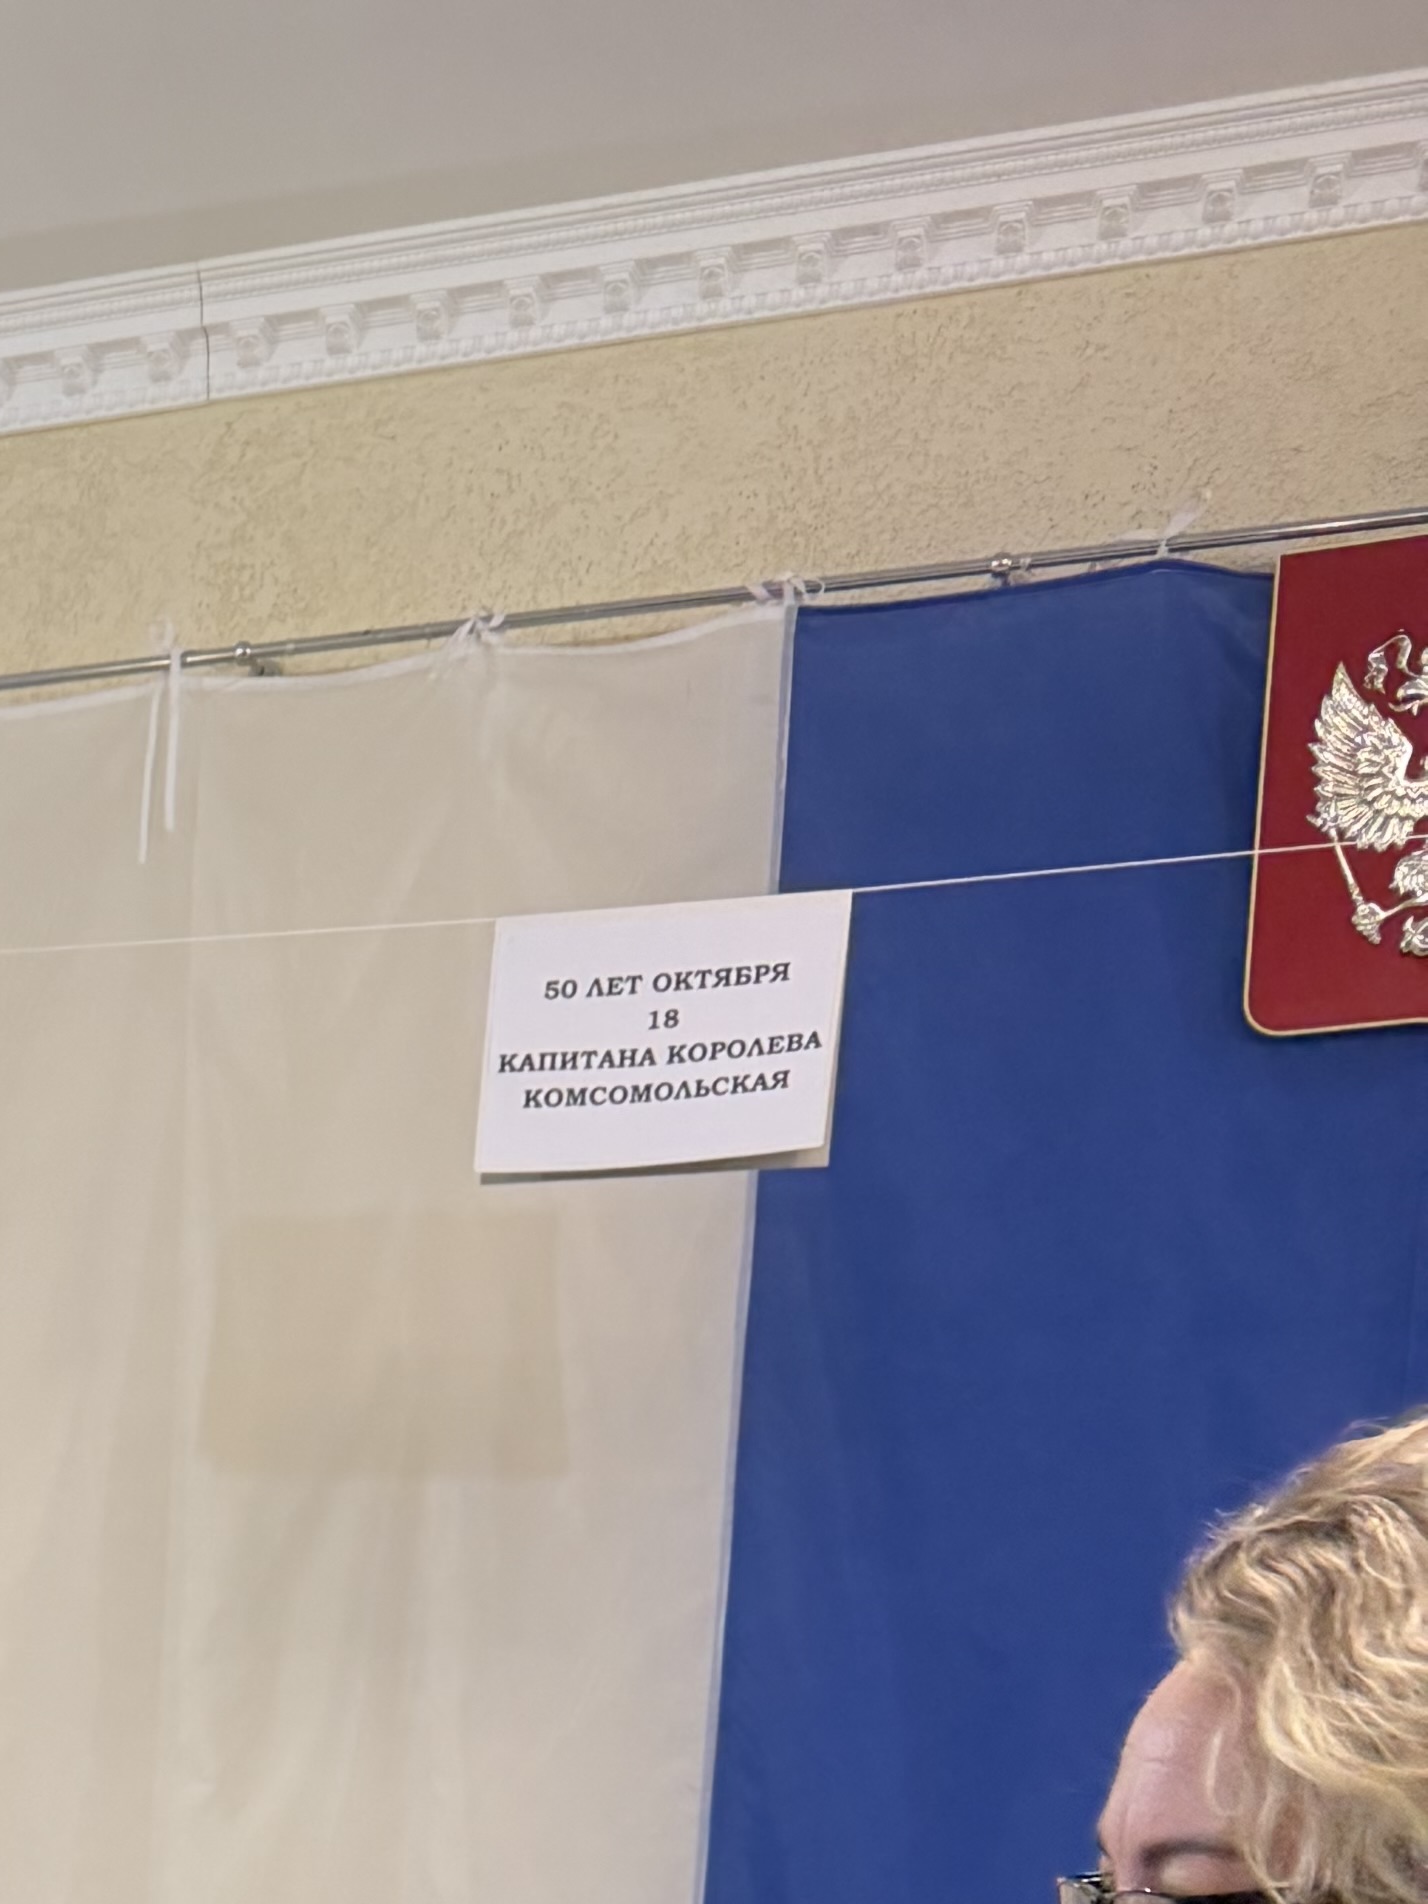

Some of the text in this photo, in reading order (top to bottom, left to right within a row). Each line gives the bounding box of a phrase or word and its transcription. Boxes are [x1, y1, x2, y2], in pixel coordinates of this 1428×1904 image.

[544, 962, 791, 1001] 50 ЛЕТ ОКТЯБРЯ
[648, 1009, 679, 1030] 18
[498, 1031, 823, 1074] КАПИТАНА КОРОЛЕВА
[522, 1070, 791, 1109] КОМСОМОЛЬСКАЯ
